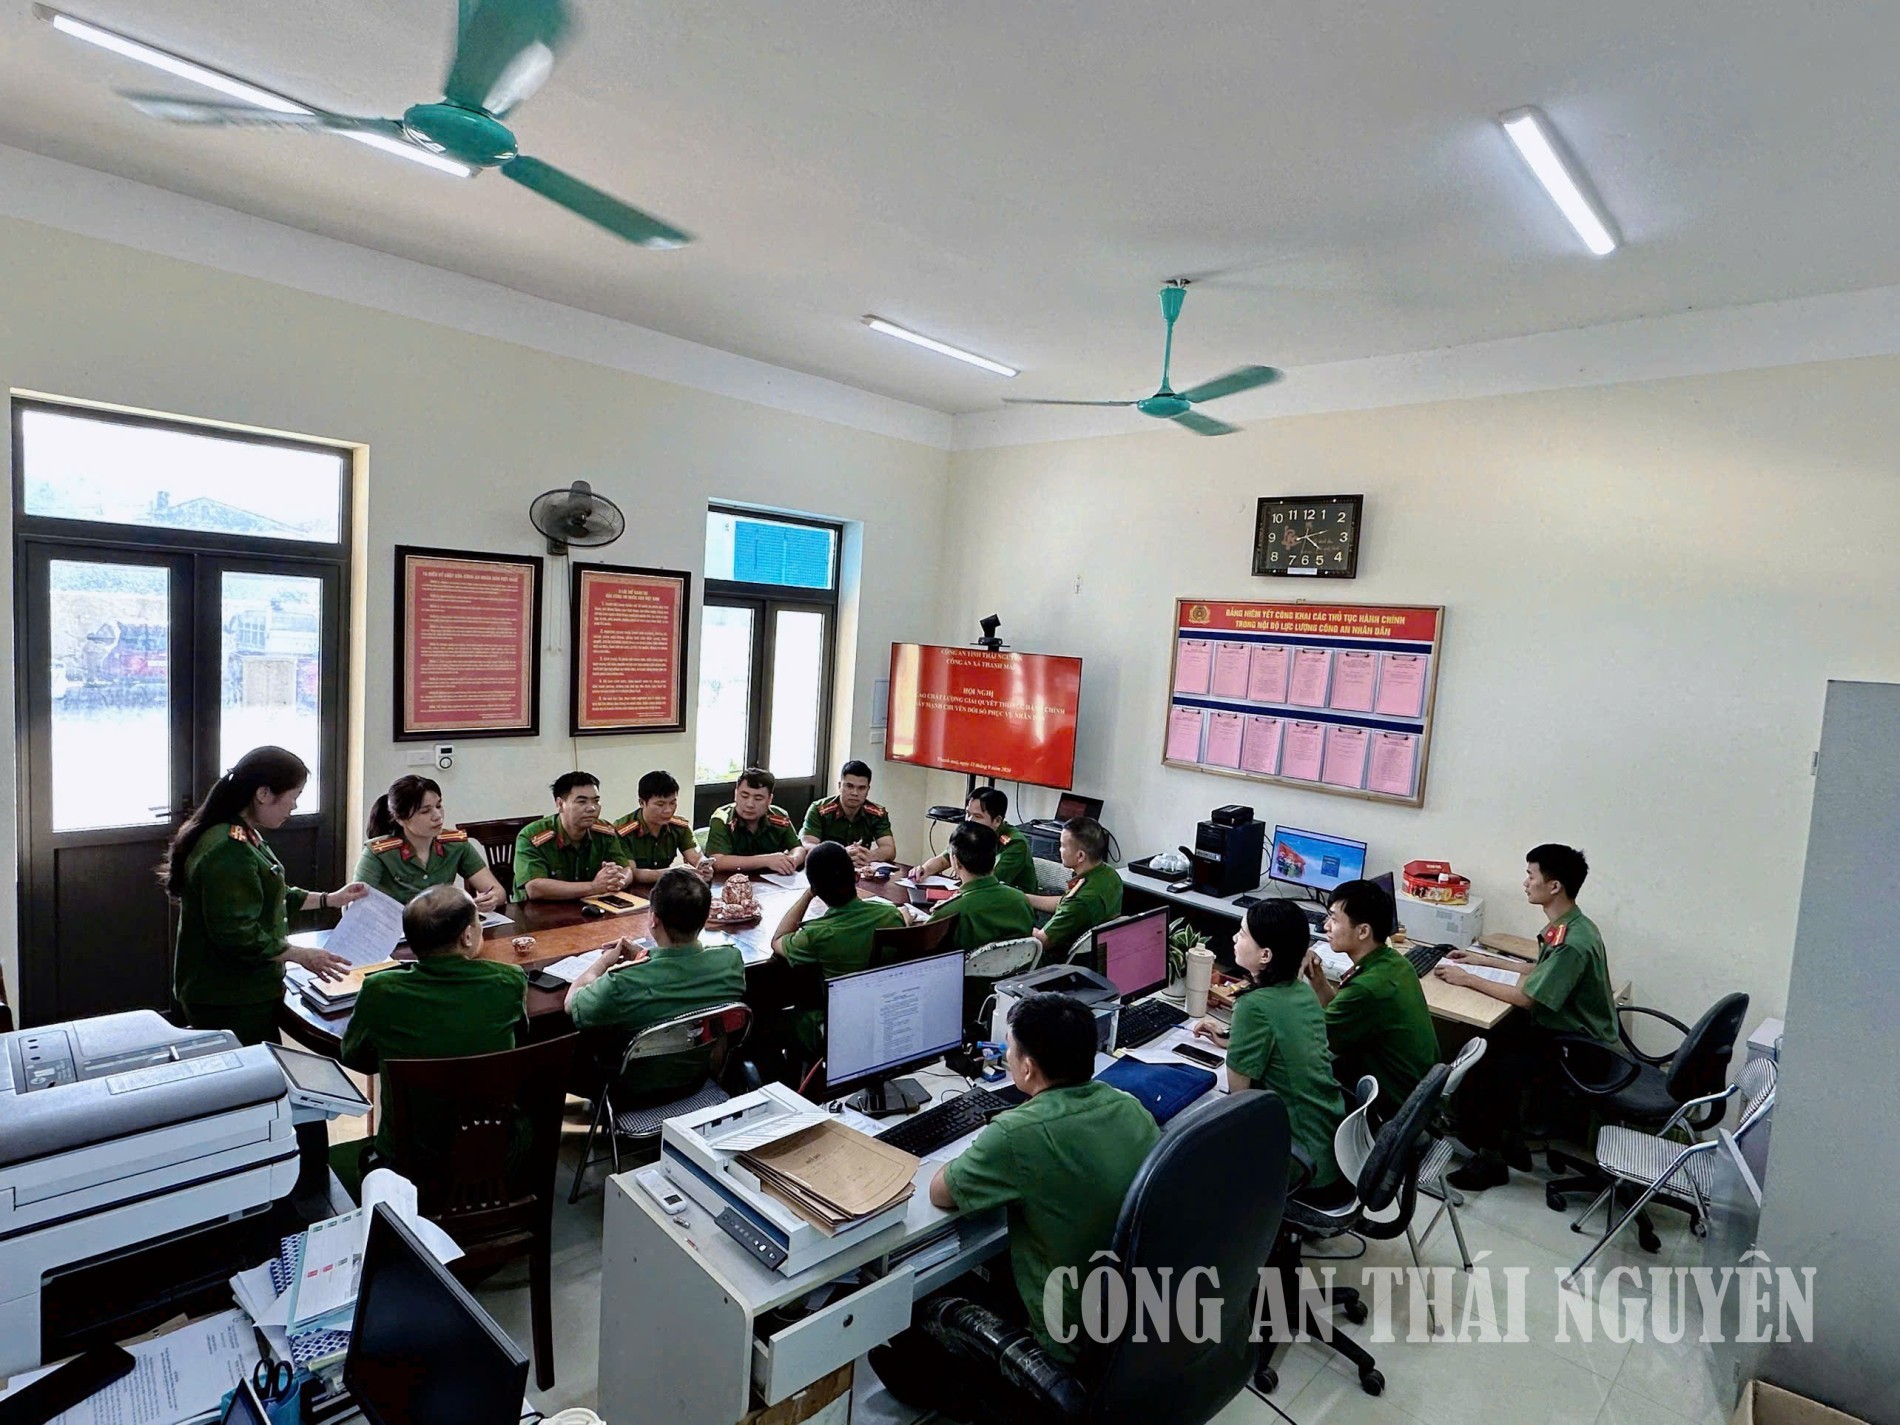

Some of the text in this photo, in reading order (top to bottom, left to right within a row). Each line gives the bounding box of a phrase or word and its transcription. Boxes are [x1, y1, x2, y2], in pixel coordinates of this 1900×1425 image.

[1272, 513, 1283, 524] 10
[1289, 510, 1298, 520] 11
[1303, 509, 1316, 520] 12
[1321, 509, 1326, 520] 1
[1337, 512, 1346, 523] 2
[1268, 533, 1276, 543] 9
[1339, 532, 1348, 543] 3
[1270, 552, 1279, 562] 8
[1288, 555, 1297, 566] 7
[1301, 555, 1309, 566] 6
[1315, 555, 1324, 566] 5
[1334, 552, 1342, 562] 4
[1275, 609, 1294, 619] CÔNG
[1295, 611, 1311, 620] KHAI
[1312, 612, 1327, 621] CÁC
[1328, 611, 1342, 622] THỦ
[1344, 613, 1358, 624] TỤC
[1236, 620, 1256, 629] TRONG
[1318, 623, 1339, 633] CÔNG
[1340, 625, 1351, 634] AN
[976, 688, 994, 698] NGHỊ
